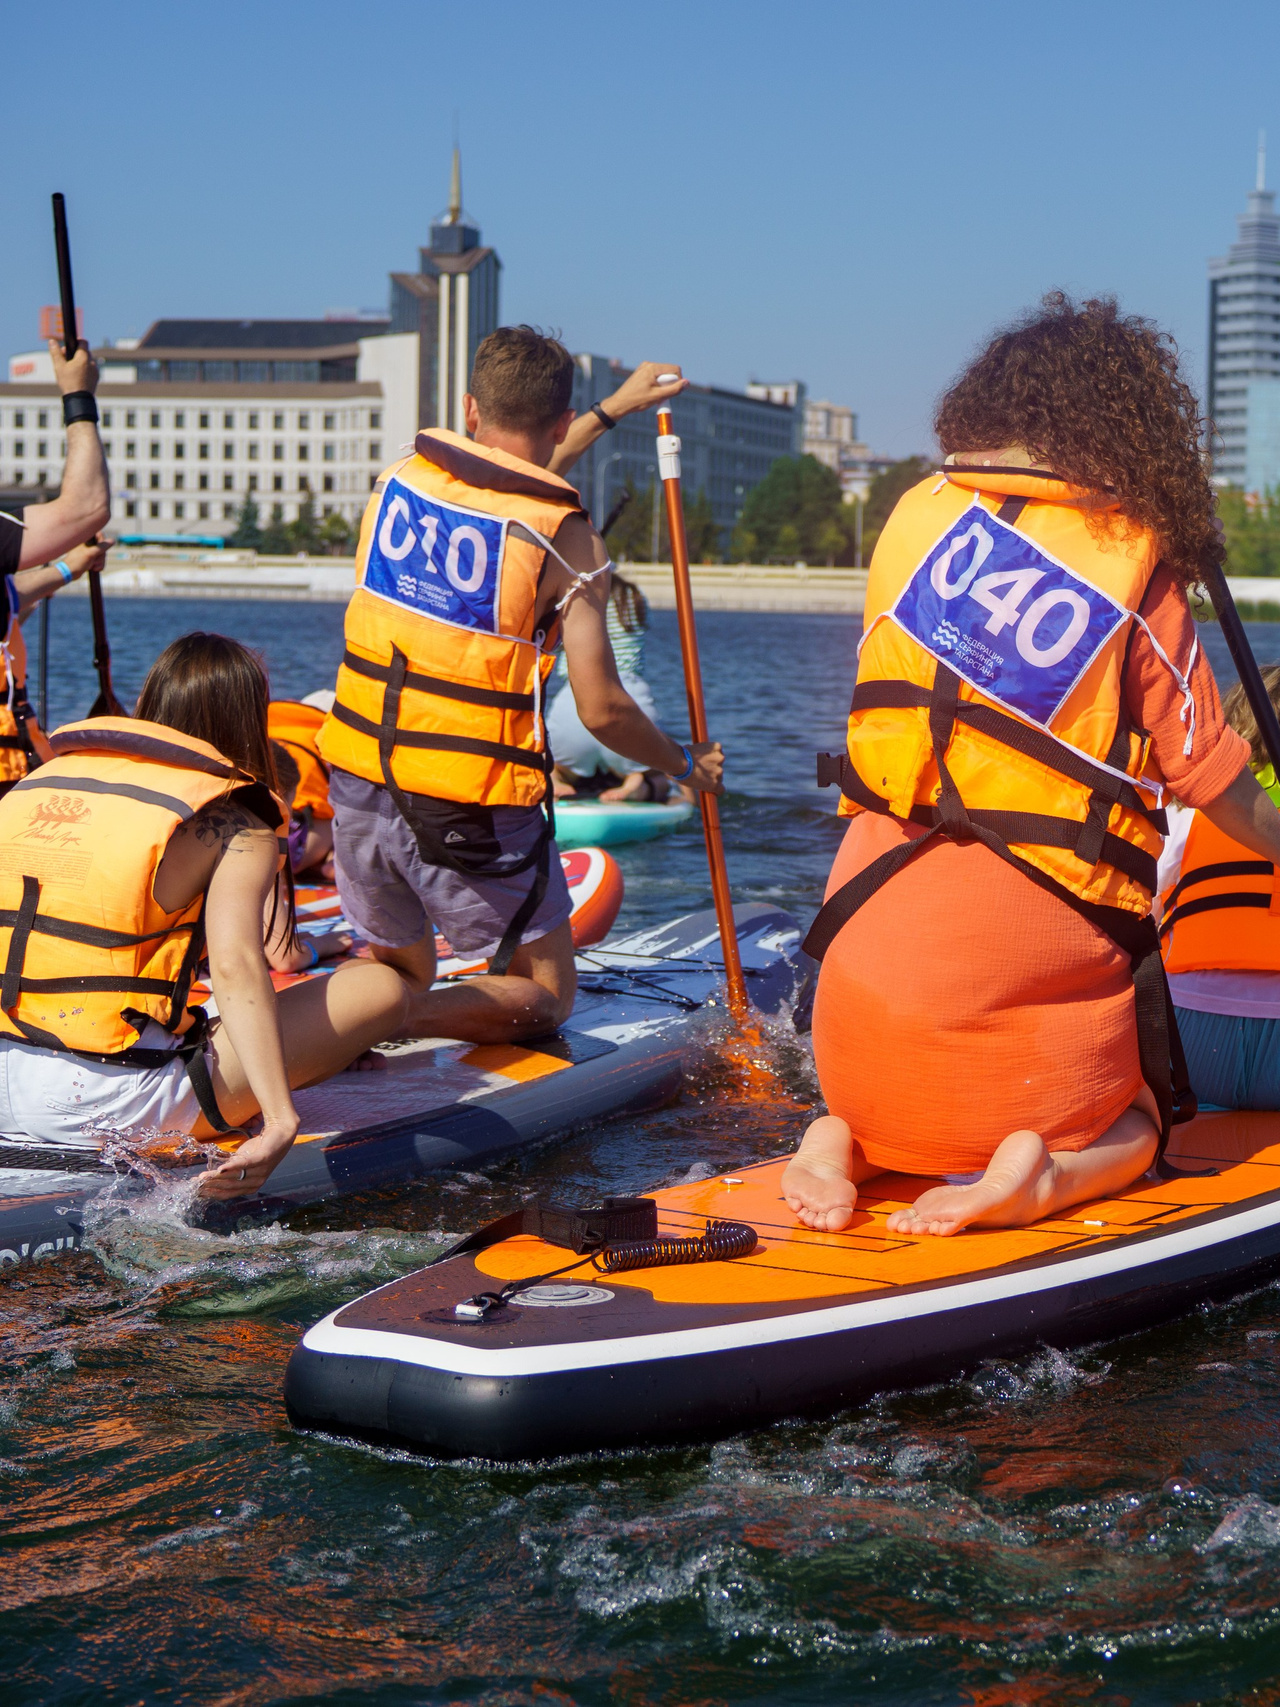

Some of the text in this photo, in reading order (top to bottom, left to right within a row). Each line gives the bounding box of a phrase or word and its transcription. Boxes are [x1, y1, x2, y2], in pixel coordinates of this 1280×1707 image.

[378, 494, 488, 593] 010
[418, 580, 454, 597] ФЕДЕРАЦИЯ
[930, 522, 1091, 668] 040
[954, 648, 995, 679] ТАТАРСТАНА
[958, 641, 994, 669] СЕРФИНГА
[962, 634, 1004, 666] ФЕДЕРАЦИЯ
